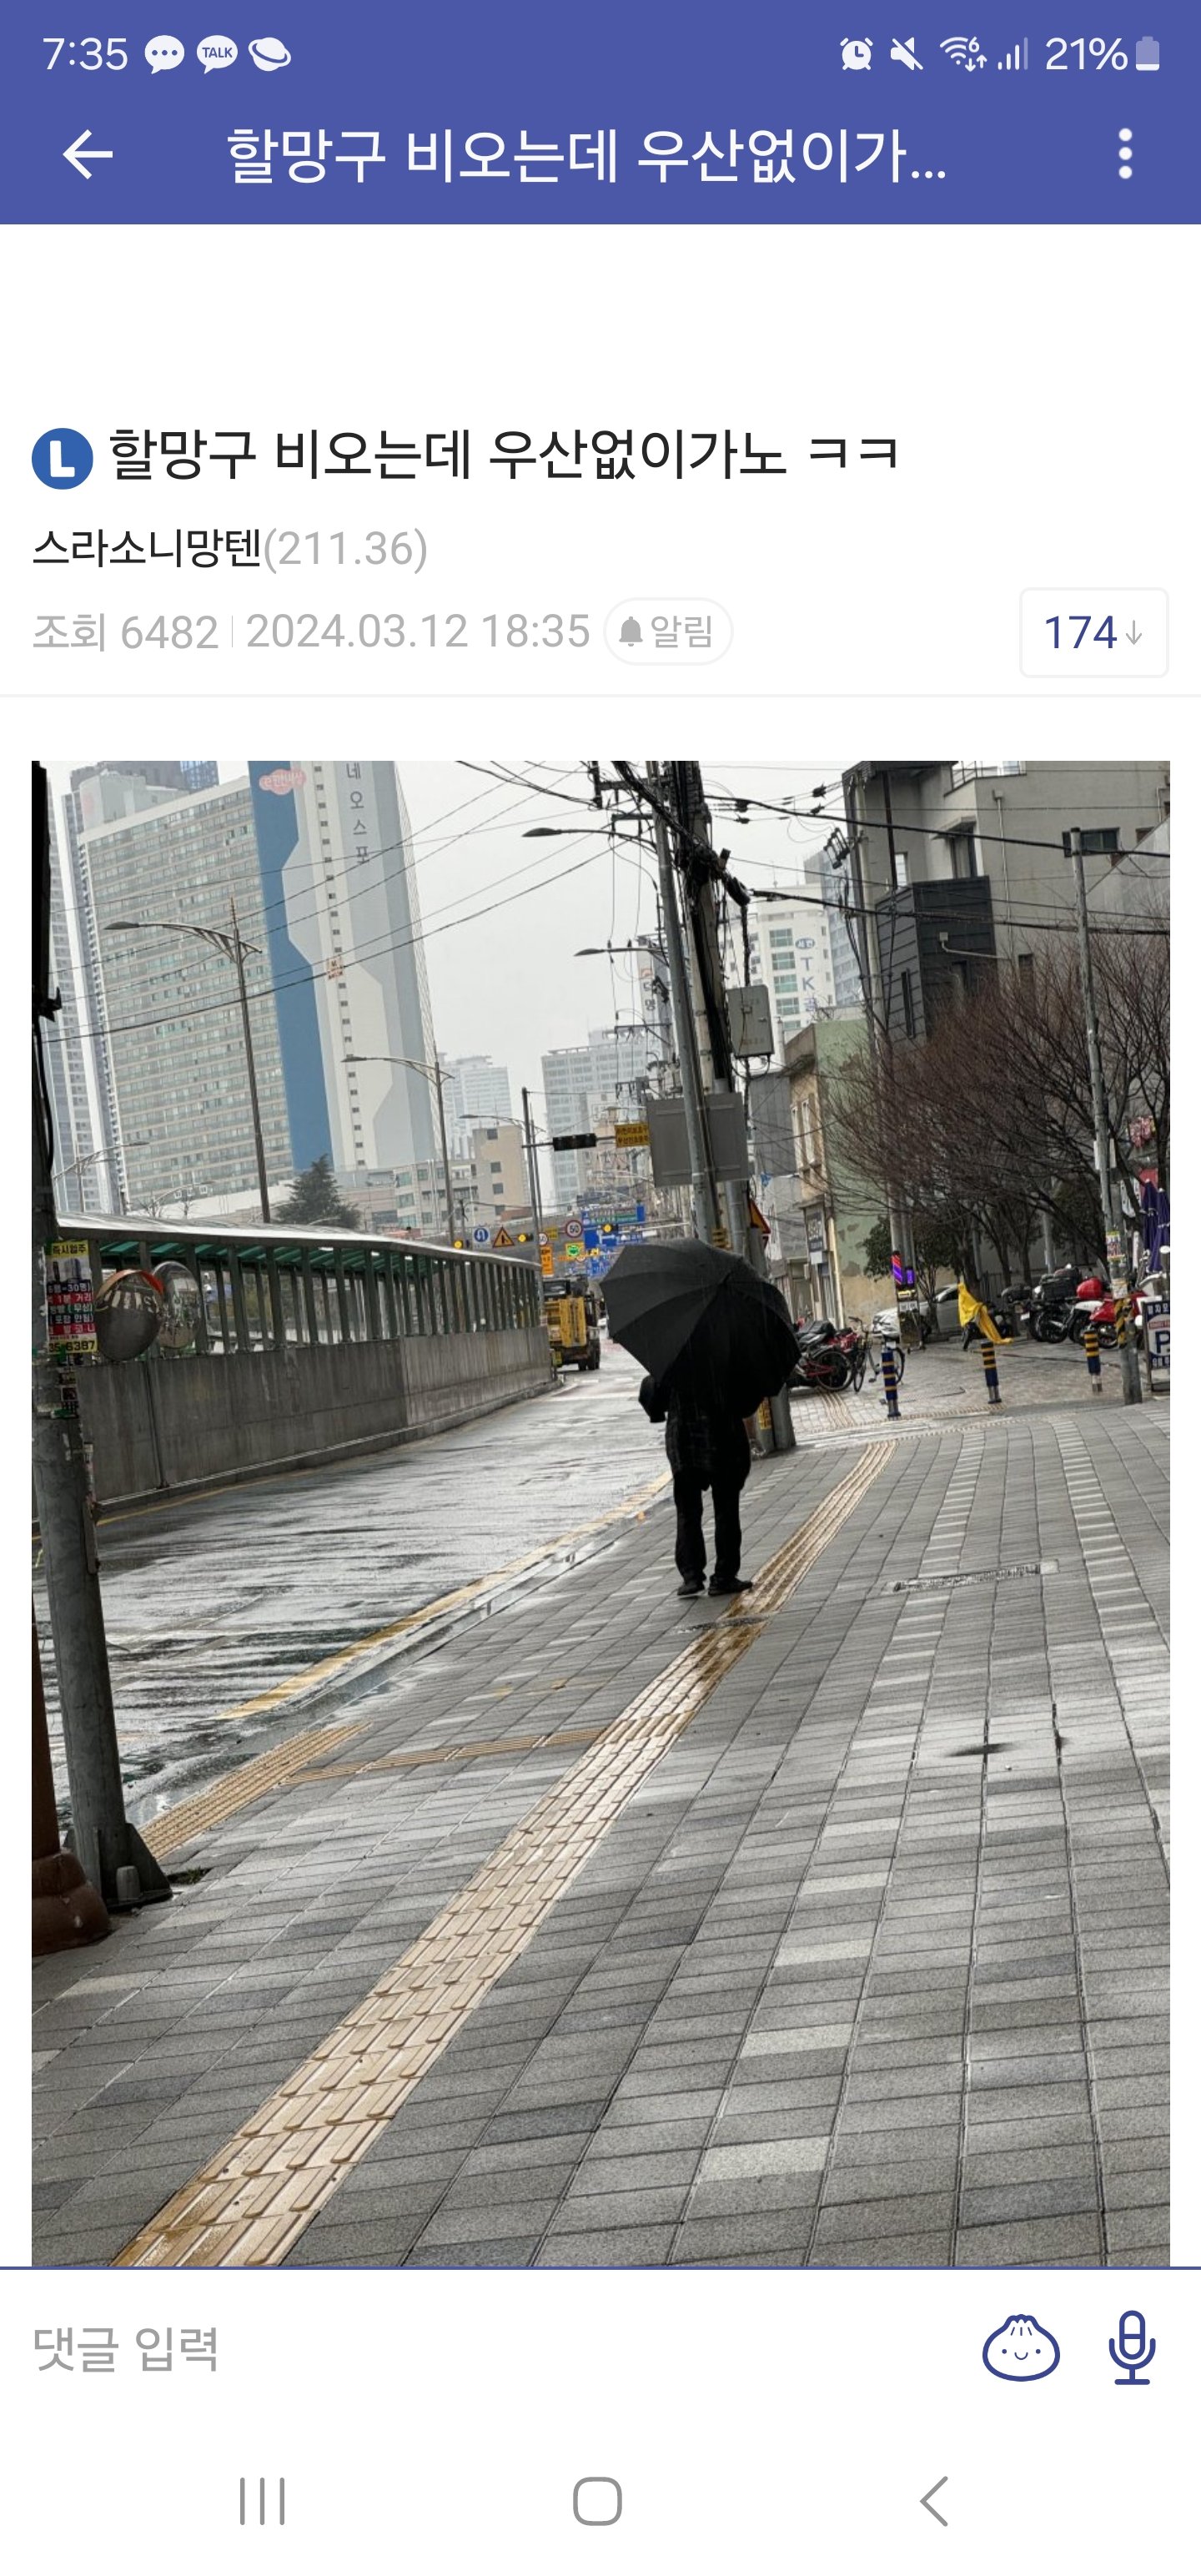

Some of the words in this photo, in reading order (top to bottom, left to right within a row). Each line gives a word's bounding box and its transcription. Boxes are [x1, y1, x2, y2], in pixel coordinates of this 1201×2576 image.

[43, 38, 128, 70] 7:35
[202, 47, 233, 58] TALK
[1046, 37, 1128, 71] 21%
[228, 128, 385, 184] 할망구
[409, 128, 616, 184] 비오는데
[638, 128, 946, 184] 우산없이가...
[50, 440, 75, 477] L
[110, 429, 256, 480] 할망구
[278, 429, 469, 480] 비오는데
[490, 429, 786, 480] 우산없이가노
[810, 438, 897, 469] ㅋㅋ
[33, 613, 105, 652] 조회
[122, 615, 219, 649] 6482
[247, 613, 468, 647] 2024.03.12
[483, 613, 589, 647] 18:35
[651, 615, 711, 648] 알림
[1045, 615, 1118, 649] 174
[346, 762, 369, 864] 네오스포
[570, 1225, 580, 1234] 50
[1155, 1331, 1170, 1354] P
[34, 2327, 119, 2373] 댓글
[135, 2327, 217, 2372] 입력
